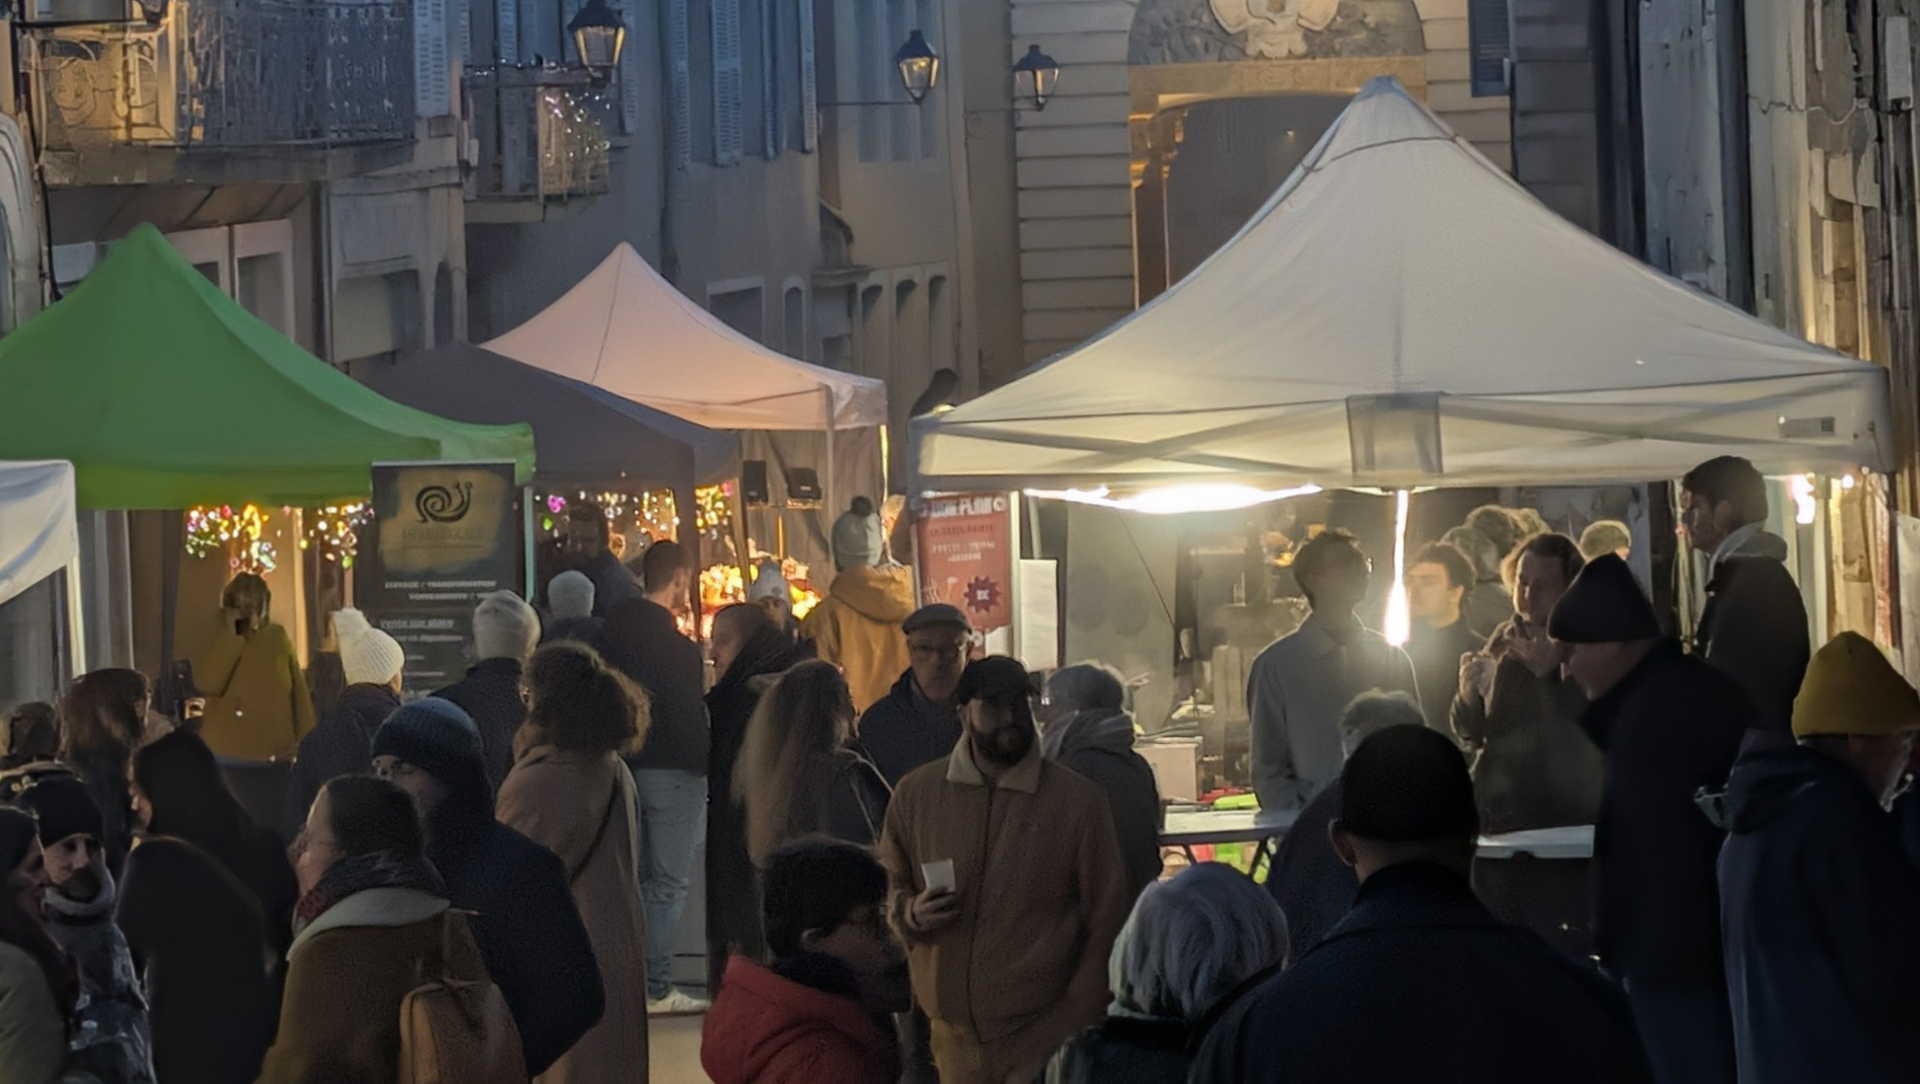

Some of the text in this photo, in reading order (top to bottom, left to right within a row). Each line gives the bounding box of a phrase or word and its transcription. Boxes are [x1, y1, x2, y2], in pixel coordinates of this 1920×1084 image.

[380, 619, 454, 630] Vente sur place
